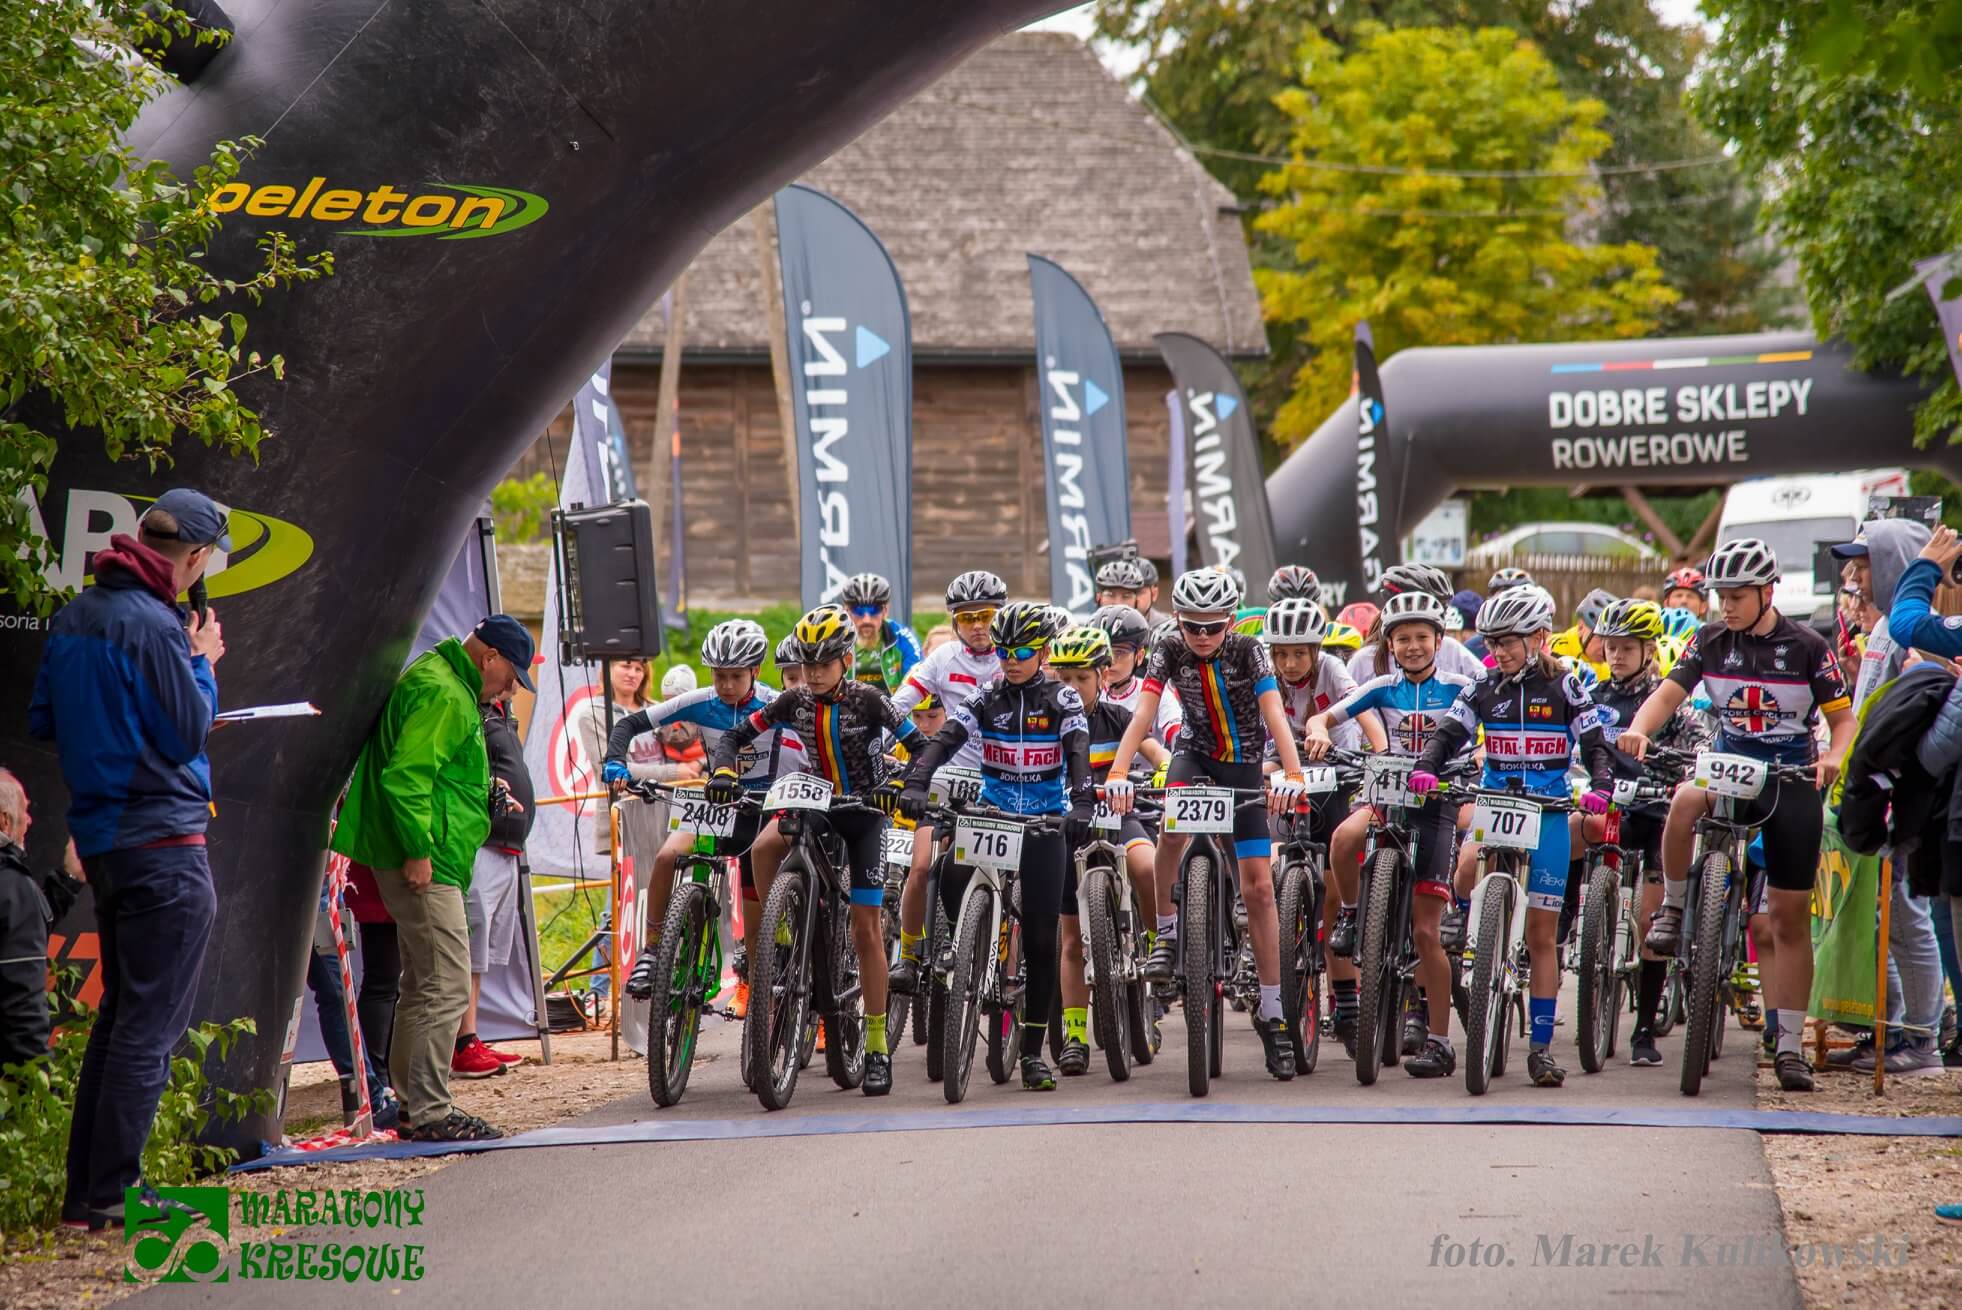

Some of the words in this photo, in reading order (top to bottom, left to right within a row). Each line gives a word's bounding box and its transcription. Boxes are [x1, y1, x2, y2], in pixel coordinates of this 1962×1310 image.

[202, 176, 506, 229] peleton
[1549, 387, 1669, 429] DOBRE
[1675, 377, 1814, 424] SKLEPY
[1551, 429, 1749, 470] ROWEROWE
[1305, 767, 1327, 783] 17
[1376, 768, 1406, 790] 41
[1709, 760, 1756, 787] 942
[681, 801, 731, 828] 2408
[1176, 799, 1227, 822] 2379
[1491, 810, 1528, 836] 707
[972, 831, 1009, 857] 716
